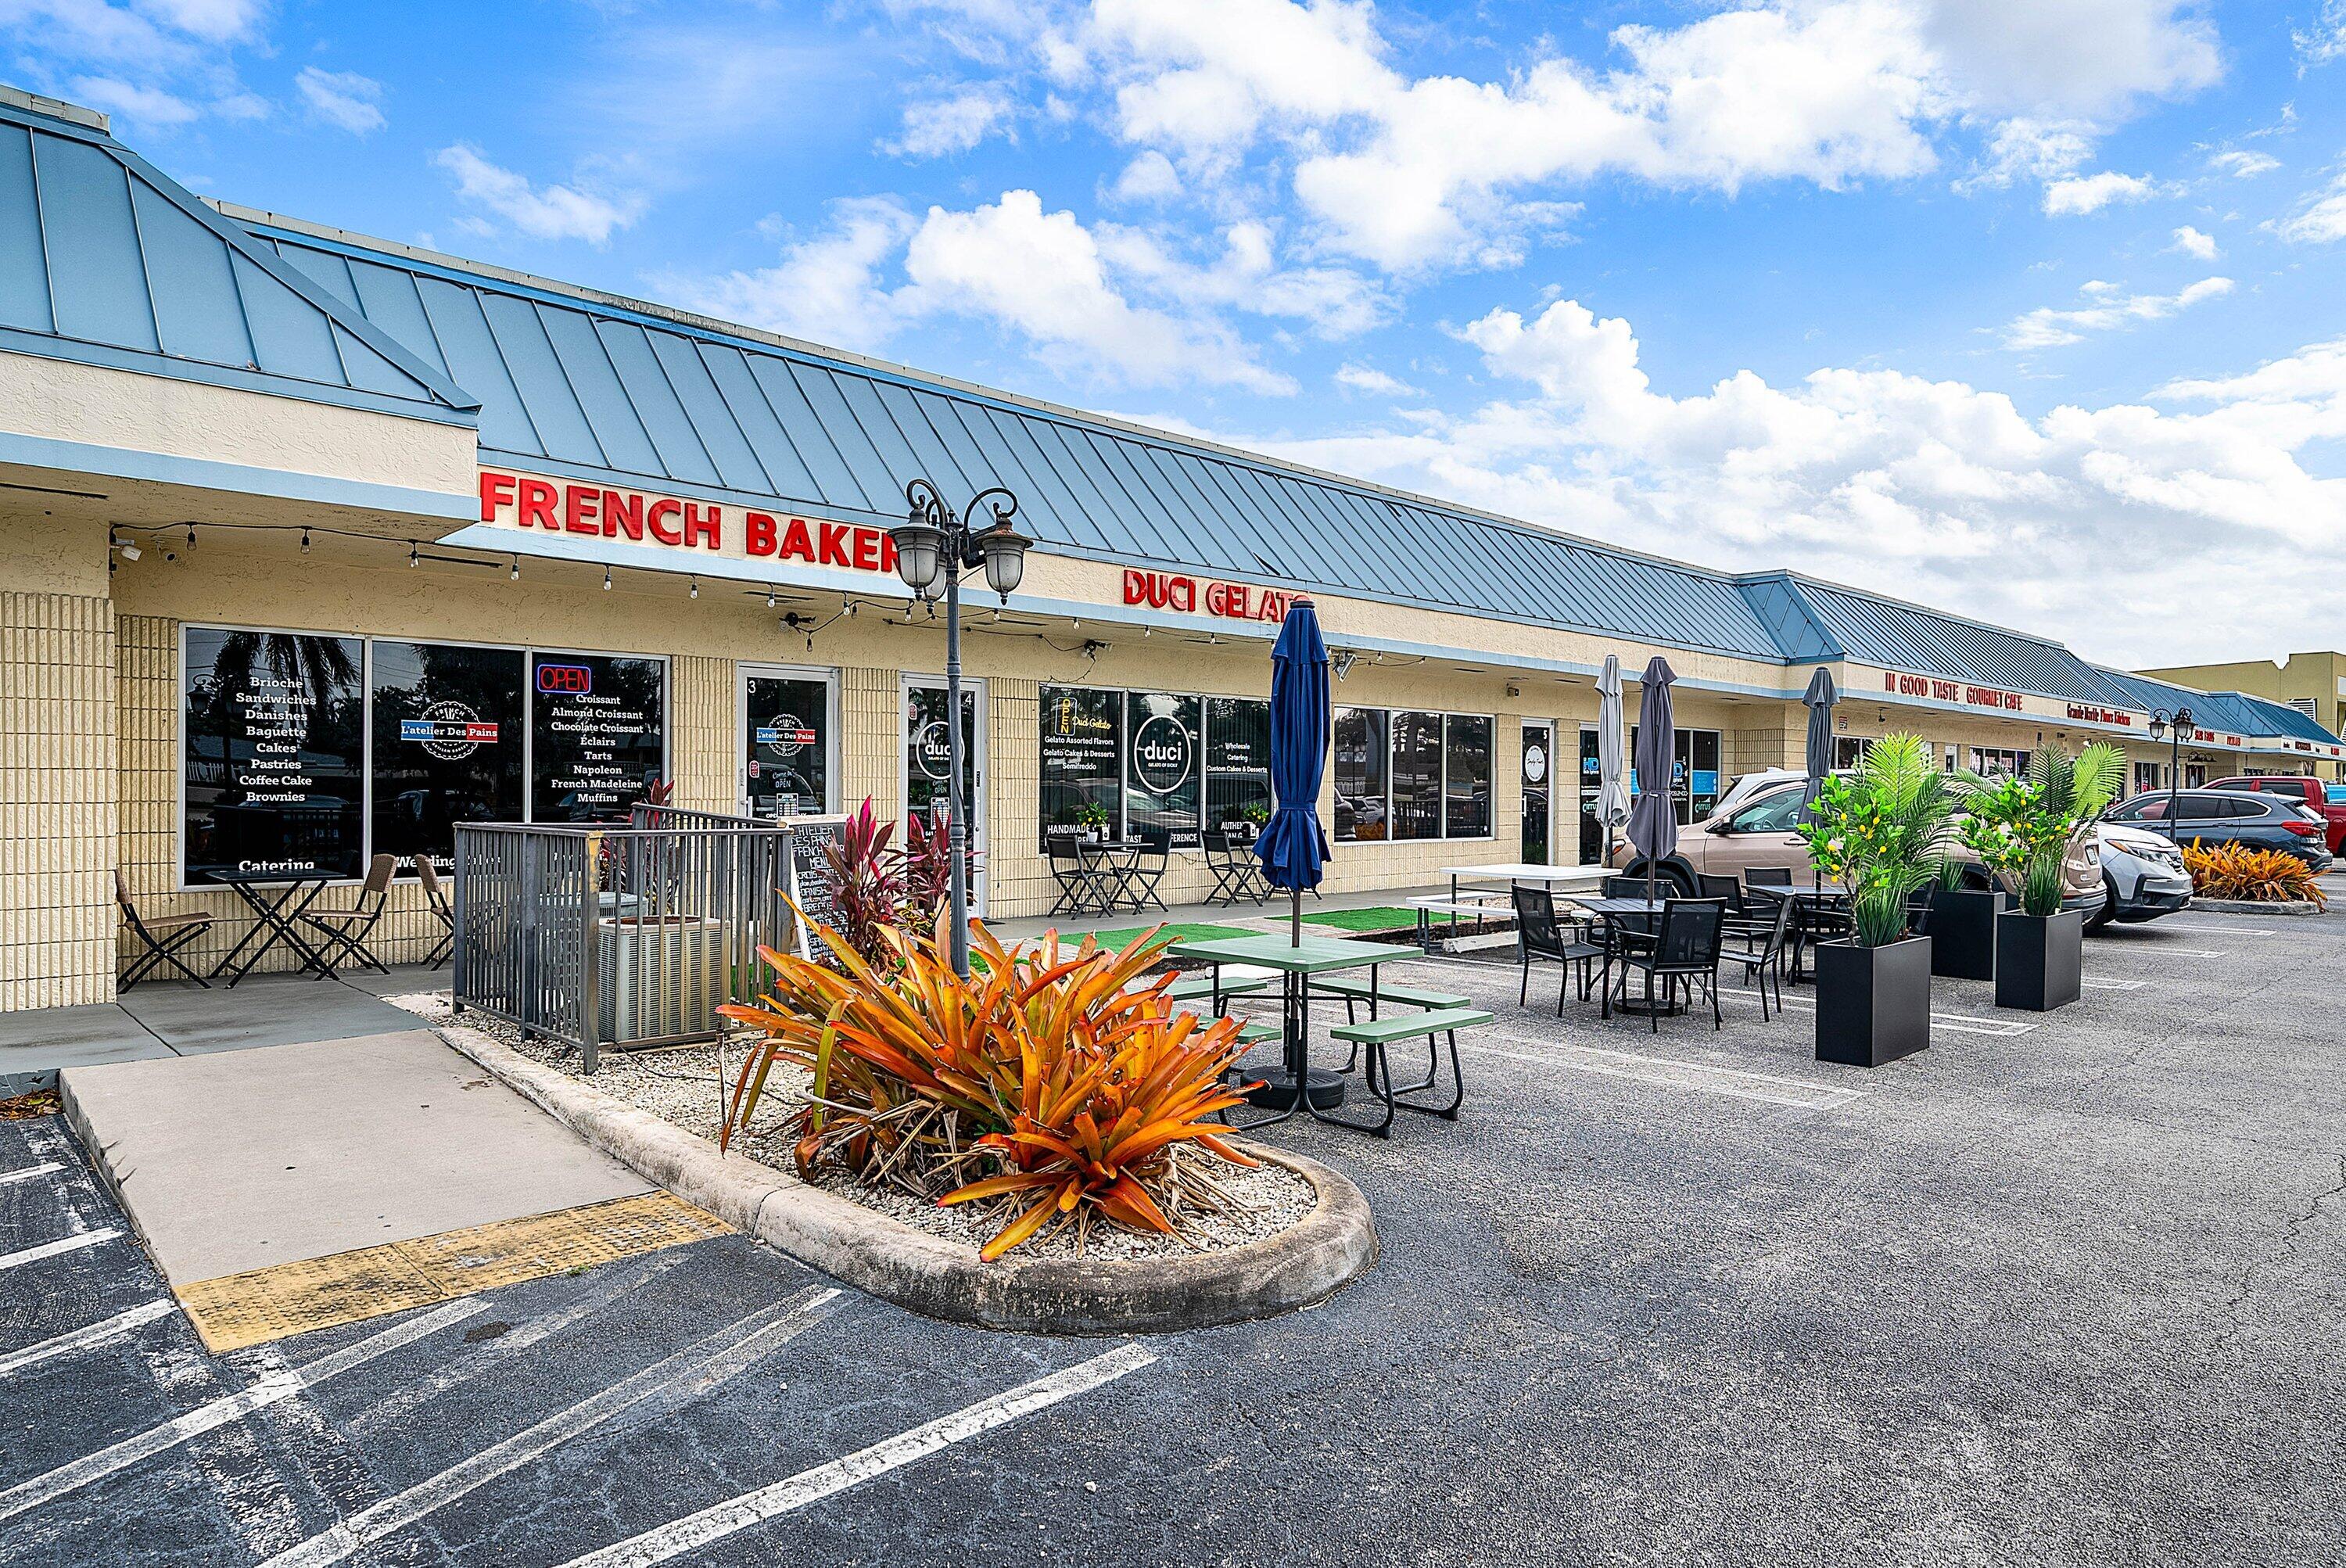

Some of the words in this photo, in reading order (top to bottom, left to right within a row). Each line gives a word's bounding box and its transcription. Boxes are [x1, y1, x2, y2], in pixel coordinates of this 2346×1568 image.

[480, 472, 721, 550] FRENCH
[745, 511, 899, 573] BAKER
[1123, 569, 1196, 612] DUCI
[1205, 583, 1311, 623] GELAT
[250, 676, 303, 688] Brioche
[540, 668, 589, 691] OPEN
[748, 680, 756, 694] 3
[1885, 672, 1896, 692] IN
[1900, 675, 1928, 697] GOOD
[1932, 680, 1958, 701] TASTE
[1966, 686, 2003, 708] GOURMET
[2004, 692, 2023, 711] CAFE
[236, 693, 317, 705] Sandwiches
[576, 694, 621, 705] Croissant
[965, 694, 972, 705] 4
[245, 709, 308, 720] Danishes
[551, 707, 593, 717] Almond
[595, 709, 643, 719] Croissant
[1060, 698, 1071, 734] OPEN
[551, 722, 599, 732] Chocolate
[600, 723, 644, 734] Croissant
[1072, 716, 1089, 727] Duci
[1089, 718, 1111, 729] Gelato
[246, 726, 307, 739] Baguette
[401, 726, 445, 735] L'atelier
[447, 727, 466, 736] Des
[469, 728, 497, 737] Pains
[1543, 730, 1548, 740] 5
[580, 734, 615, 746] Éclairs
[256, 743, 296, 753] Cakes
[925, 740, 951, 755] duc
[1144, 740, 1182, 761] duci
[584, 751, 612, 760] Tarts
[1227, 754, 1249, 762] Catering
[251, 759, 302, 770] Pastries
[1062, 762, 1097, 770] Semifreddo
[573, 765, 622, 777] Napoleon
[239, 775, 279, 785] Coffee
[281, 775, 312, 785] Cake
[551, 779, 587, 788] French
[590, 779, 643, 789] Madeleine
[775, 780, 791, 788] OPEN
[246, 791, 306, 802] Brownies
[577, 793, 618, 802] Muffins
[1048, 823, 1090, 834] HANDMADE
[1221, 821, 1243, 831] AUTHEN
[1126, 834, 1143, 844] TAST
[1171, 833, 1197, 843] FERENCE
[396, 855, 455, 870] Weing
